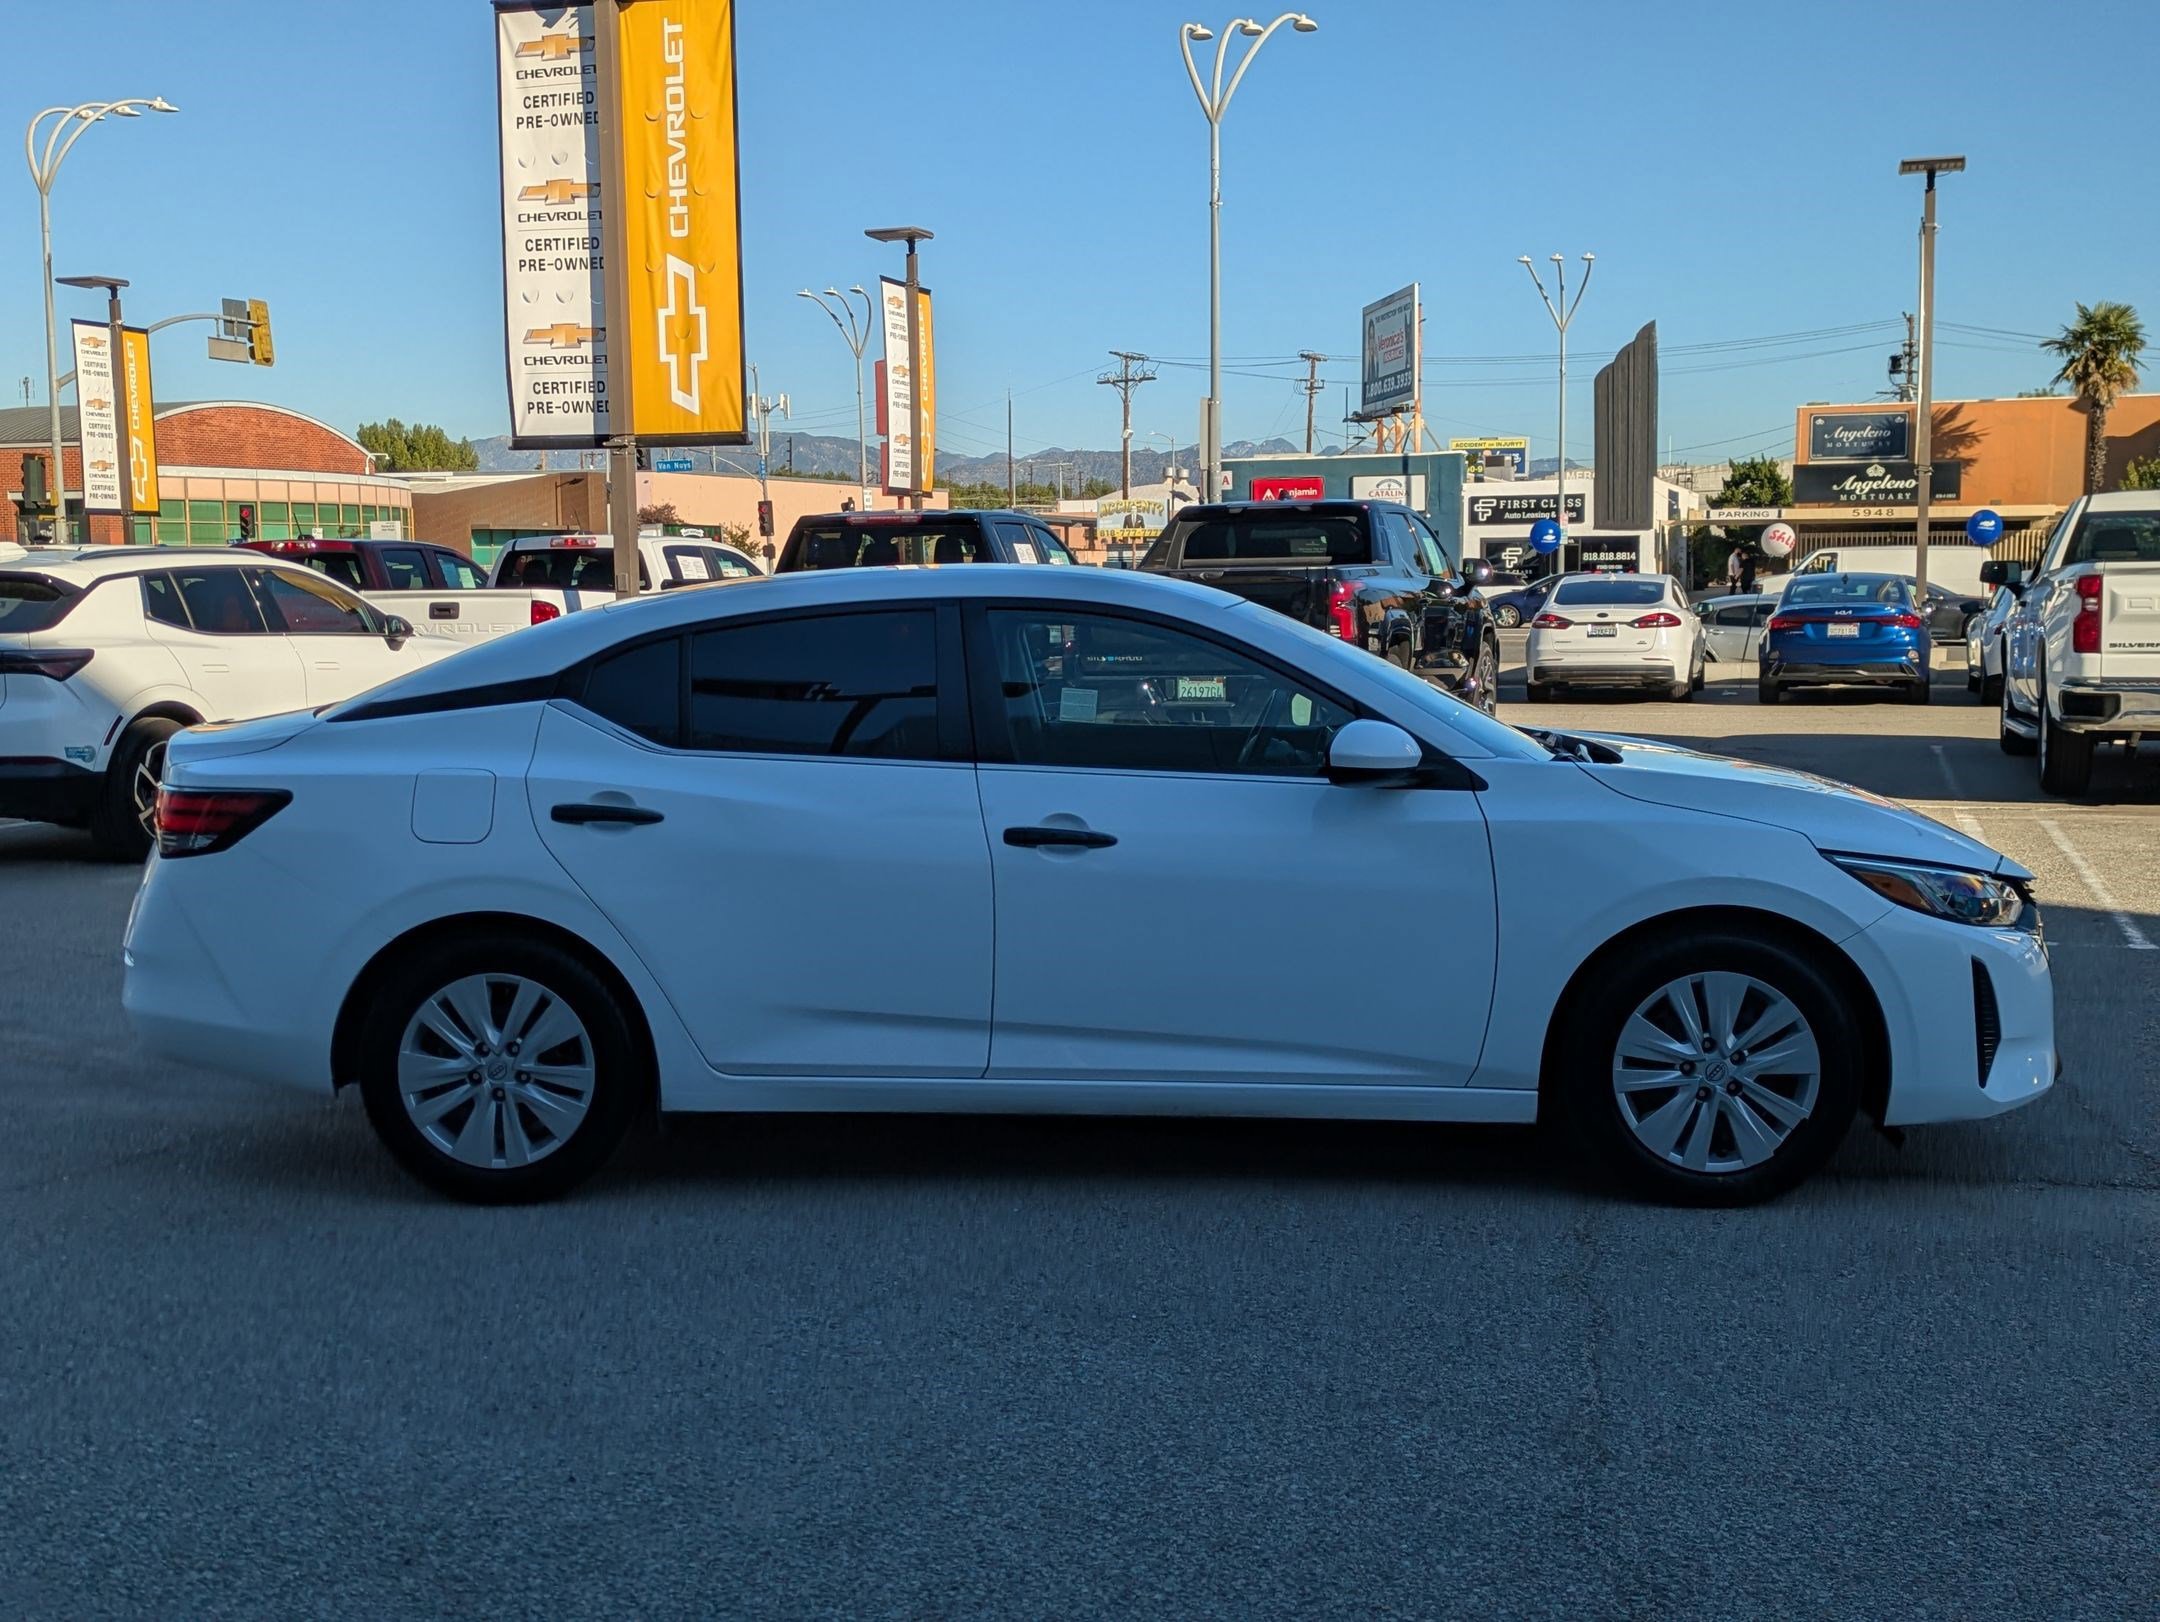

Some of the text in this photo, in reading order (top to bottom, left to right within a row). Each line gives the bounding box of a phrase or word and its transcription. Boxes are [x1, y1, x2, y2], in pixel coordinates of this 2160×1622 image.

[523, 91, 595, 110] CERTIFIED
[663, 17, 689, 238] CHEVROLET
[525, 236, 601, 252] CERTIFIED
[127, 340, 140, 430] CHEVROLET
[532, 380, 606, 395] CERTIFIED
[1824, 425, 1892, 442] Angeleno
[1826, 440, 1891, 448] MORTUARY
[657, 461, 691, 470] Van Nuys
[1832, 474, 1918, 495] Angeleno
[1368, 489, 1410, 498] CATALINA
[1840, 492, 1911, 501] MORTUARY
[1499, 498, 1582, 509] FIRST CLSS
[1504, 511, 1521, 519] Auto
[1521, 511, 1550, 520] Leasing
[1718, 510, 1770, 518] PARKING
[1852, 508, 1895, 517] 5948
[1583, 552, 1636, 561] 818.818.8814
